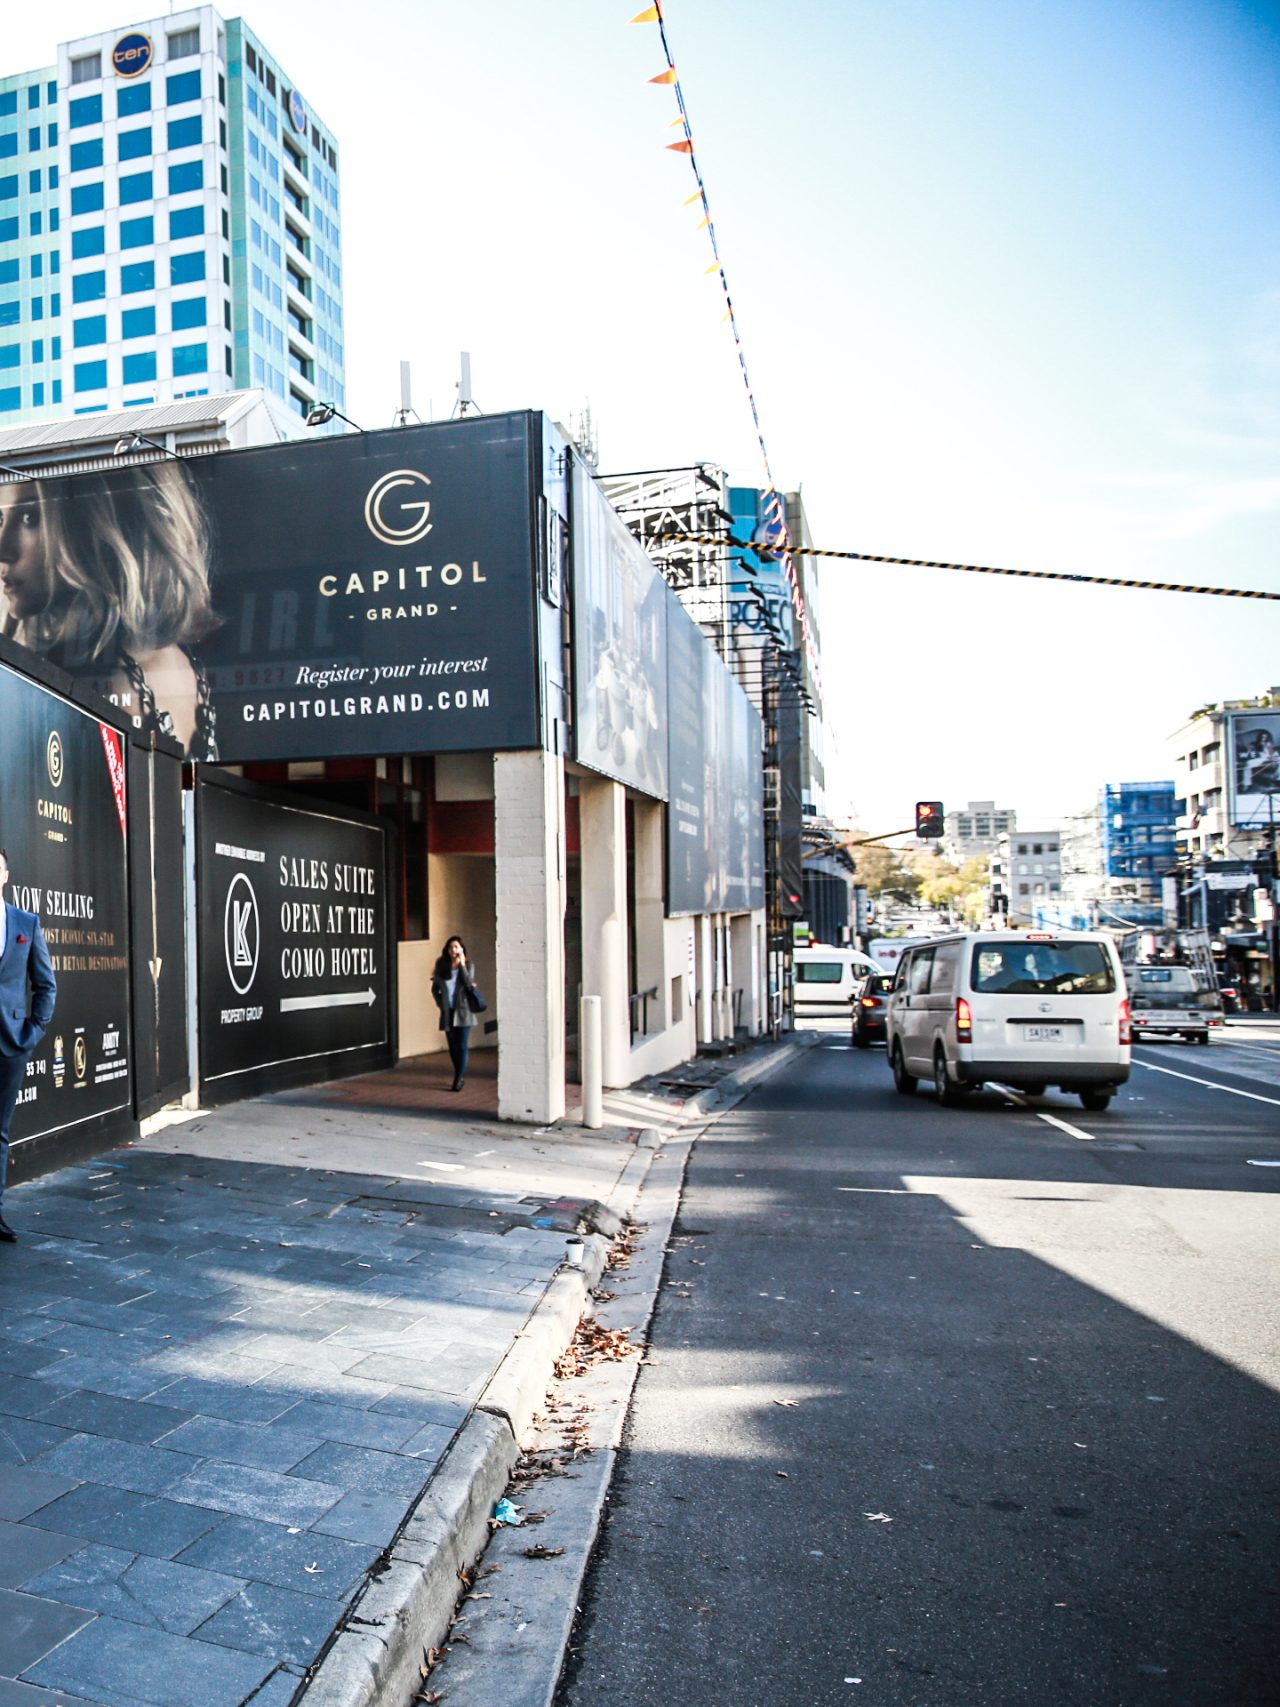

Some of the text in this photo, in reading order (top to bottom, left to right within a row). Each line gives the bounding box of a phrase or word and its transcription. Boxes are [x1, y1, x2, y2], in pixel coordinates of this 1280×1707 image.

[113, 43, 150, 63] ten
[319, 561, 487, 597] CAPITOL
[366, 603, 439, 621] GRAND
[296, 656, 489, 689] Register your interest
[243, 689, 490, 722] CAPITOLGRAND.COM
[37, 798, 73, 825] CAPITOL
[280, 855, 375, 896] SALES SUITE
[12, 885, 94, 919] NOW SELLING
[281, 902, 375, 935] OPEN AT THE
[281, 947, 377, 979] COMO HOTEL
[221, 1006, 264, 1024] PROPERTY GROUP
